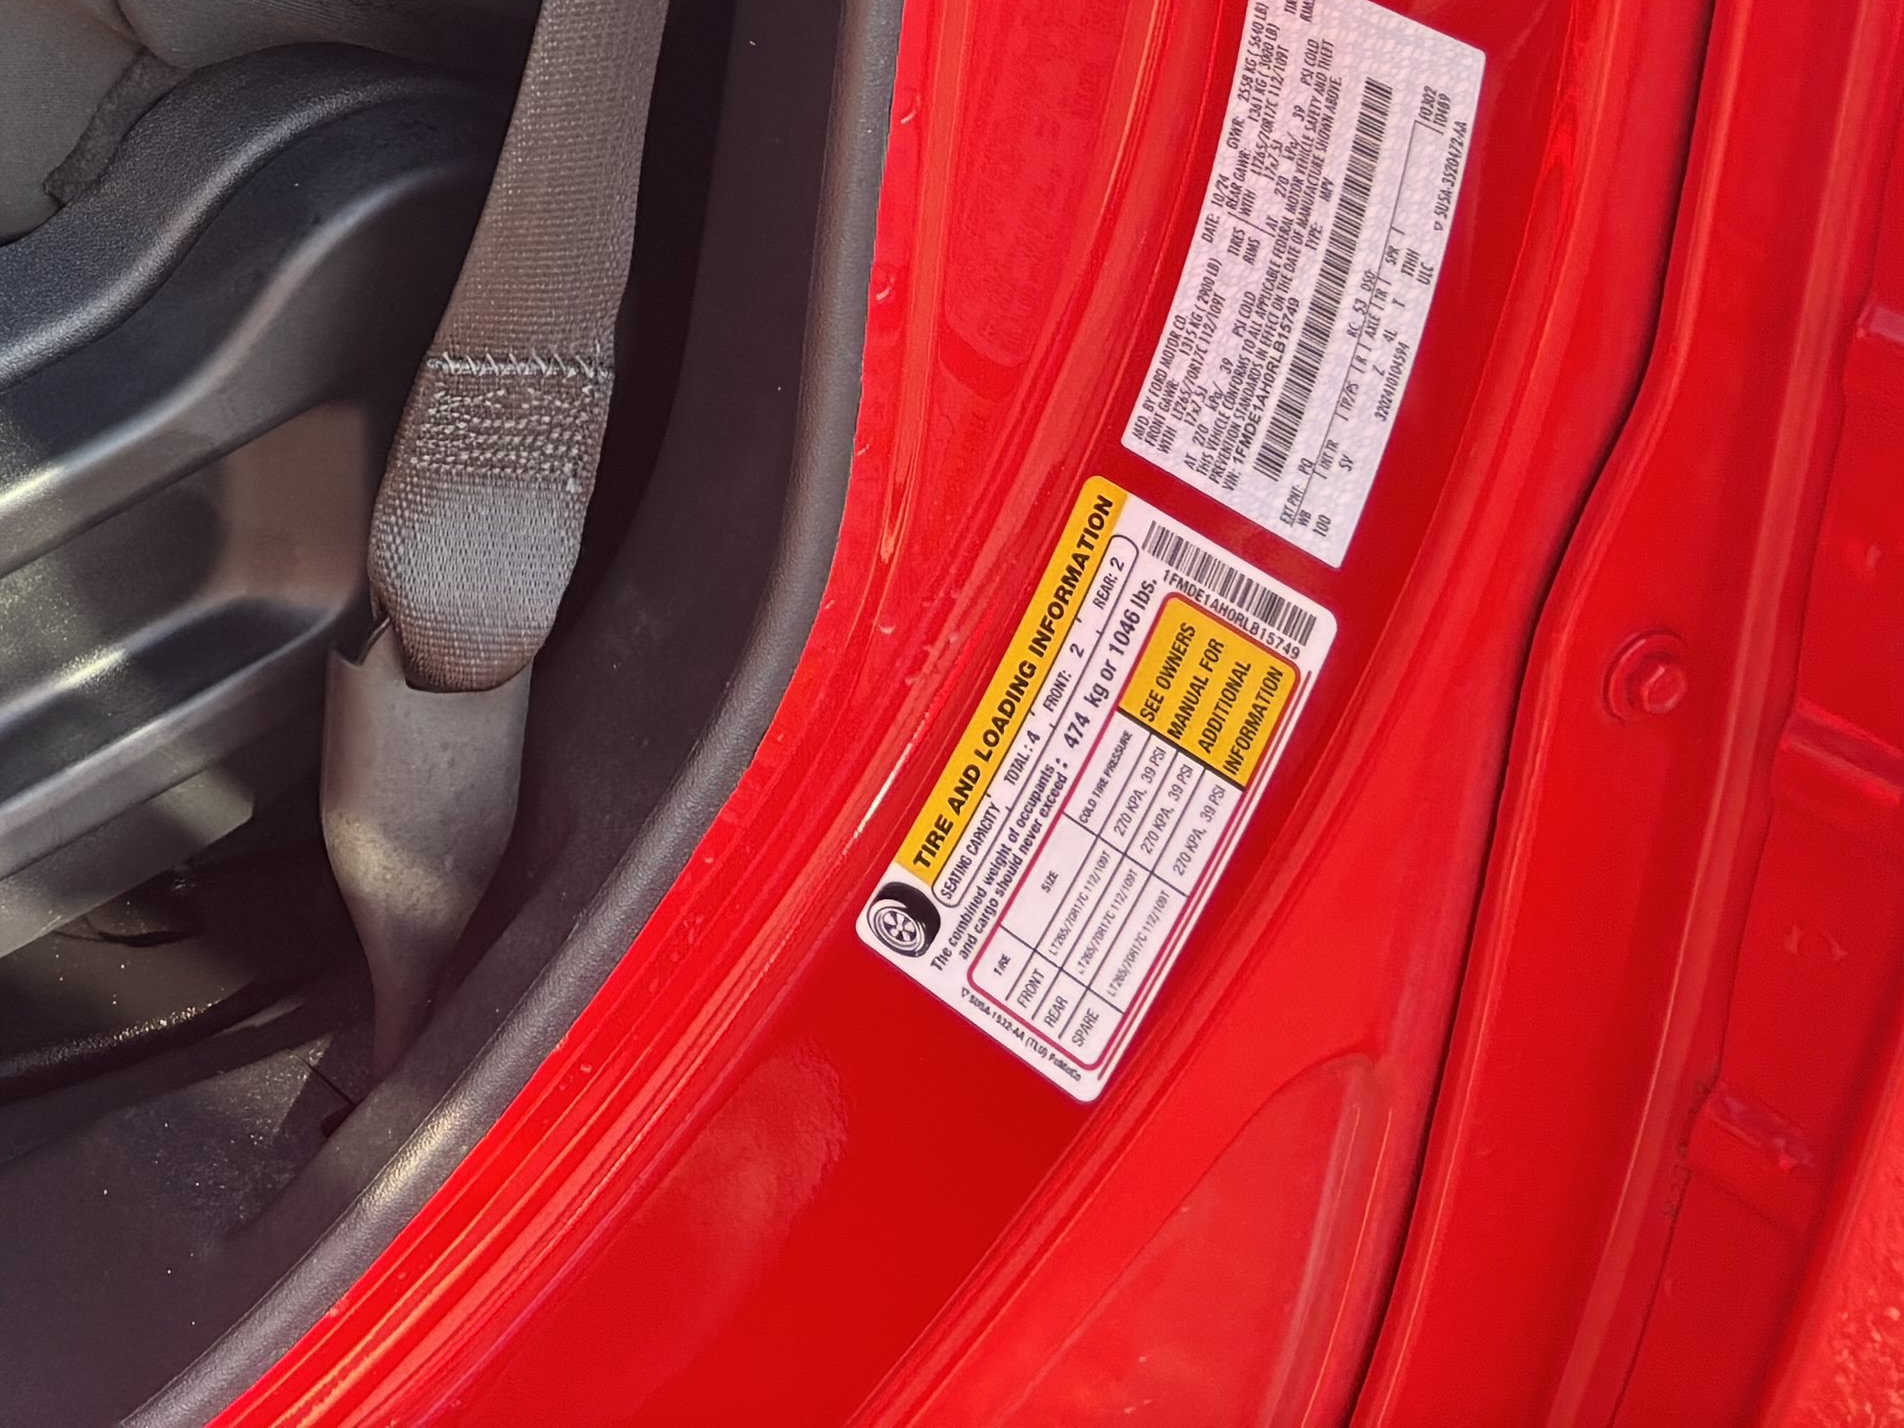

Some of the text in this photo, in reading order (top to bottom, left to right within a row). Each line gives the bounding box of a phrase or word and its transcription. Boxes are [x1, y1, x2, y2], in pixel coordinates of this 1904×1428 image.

[1243, 56, 1257, 74] KG
[1225, 181, 1243, 211] REAR
[1253, 77, 1268, 96] KG
[1264, 37, 1319, 232] AT 270 39 PSI COLD
[1210, 172, 1230, 208] 10/24
[1238, 188, 1256, 217] WITH
[1304, 175, 1335, 251] TYPE: MPV
[1195, 37, 1334, 477] THIS VEHICLE CONFORMS TO ALL APPLICABLE FEDERAL MOTOR VEHICLE SAFETY AND THEFT
[1227, 226, 1246, 257] TIRES
[1205, 256, 1222, 277] LB)
[1196, 275, 1215, 305] 2900
[1208, 112, 1334, 485] PREVENTION STANDARDS IN EFFECT ON THE DATE OF MANUFACTURE SHOWN
[1352, 297, 1368, 316] 53
[1172, 312, 1189, 331] CO.
[1188, 310, 1203, 329] KG
[1159, 329, 1183, 369] MOTOR
[1178, 327, 1198, 357] 1315
[1148, 367, 1169, 398] FORD
[1183, 289, 1257, 470] AT 270 39 PSI COLD
[1295, 242, 1400, 527] WB AXLE SPR
[1142, 395, 1157, 413] BY
[1143, 411, 1167, 447] FRONT
[1157, 425, 1178, 455] WITH
[1221, 467, 1242, 492] VIN:
[1311, 453, 1355, 538] 100 SV
[1091, 555, 1125, 610] REAR: 2
[1041, 641, 1085, 713] FRONT: 2
[1061, 575, 1159, 751] 474 kg or 1046 lbs.
[1138, 620, 1197, 723] SEE OWNERS
[911, 493, 1114, 870] TIRE AND LOADING INFORMATION
[1165, 636, 1225, 741] MANUAL FOR
[1196, 658, 1252, 754] ADDITIONAL
[1221, 664, 1284, 776] INFORMATION
[1025, 729, 1041, 745] 4
[1148, 745, 1167, 768] PSI
[1175, 762, 1195, 786] PSI
[1077, 728, 1134, 825] COLD TIRE PRESSURE
[1140, 765, 1157, 784] 39
[1167, 782, 1185, 802] 39
[1207, 783, 1227, 807] PSI
[1112, 811, 1133, 837] 270
[1199, 803, 1217, 823] 39
[939, 800, 1001, 900] SEATING CAPACITY
[1139, 829, 1160, 855] 270
[930, 762, 1056, 972] The combined weight of occupants
[957, 771, 1069, 961] and cargo should never exceed
[1171, 850, 1193, 877] 270
[1039, 869, 1059, 894] SIZE
[1015, 967, 1045, 1009] FRONT
[1042, 994, 1069, 1028] REAR
[1070, 1006, 1100, 1048] SPARE
